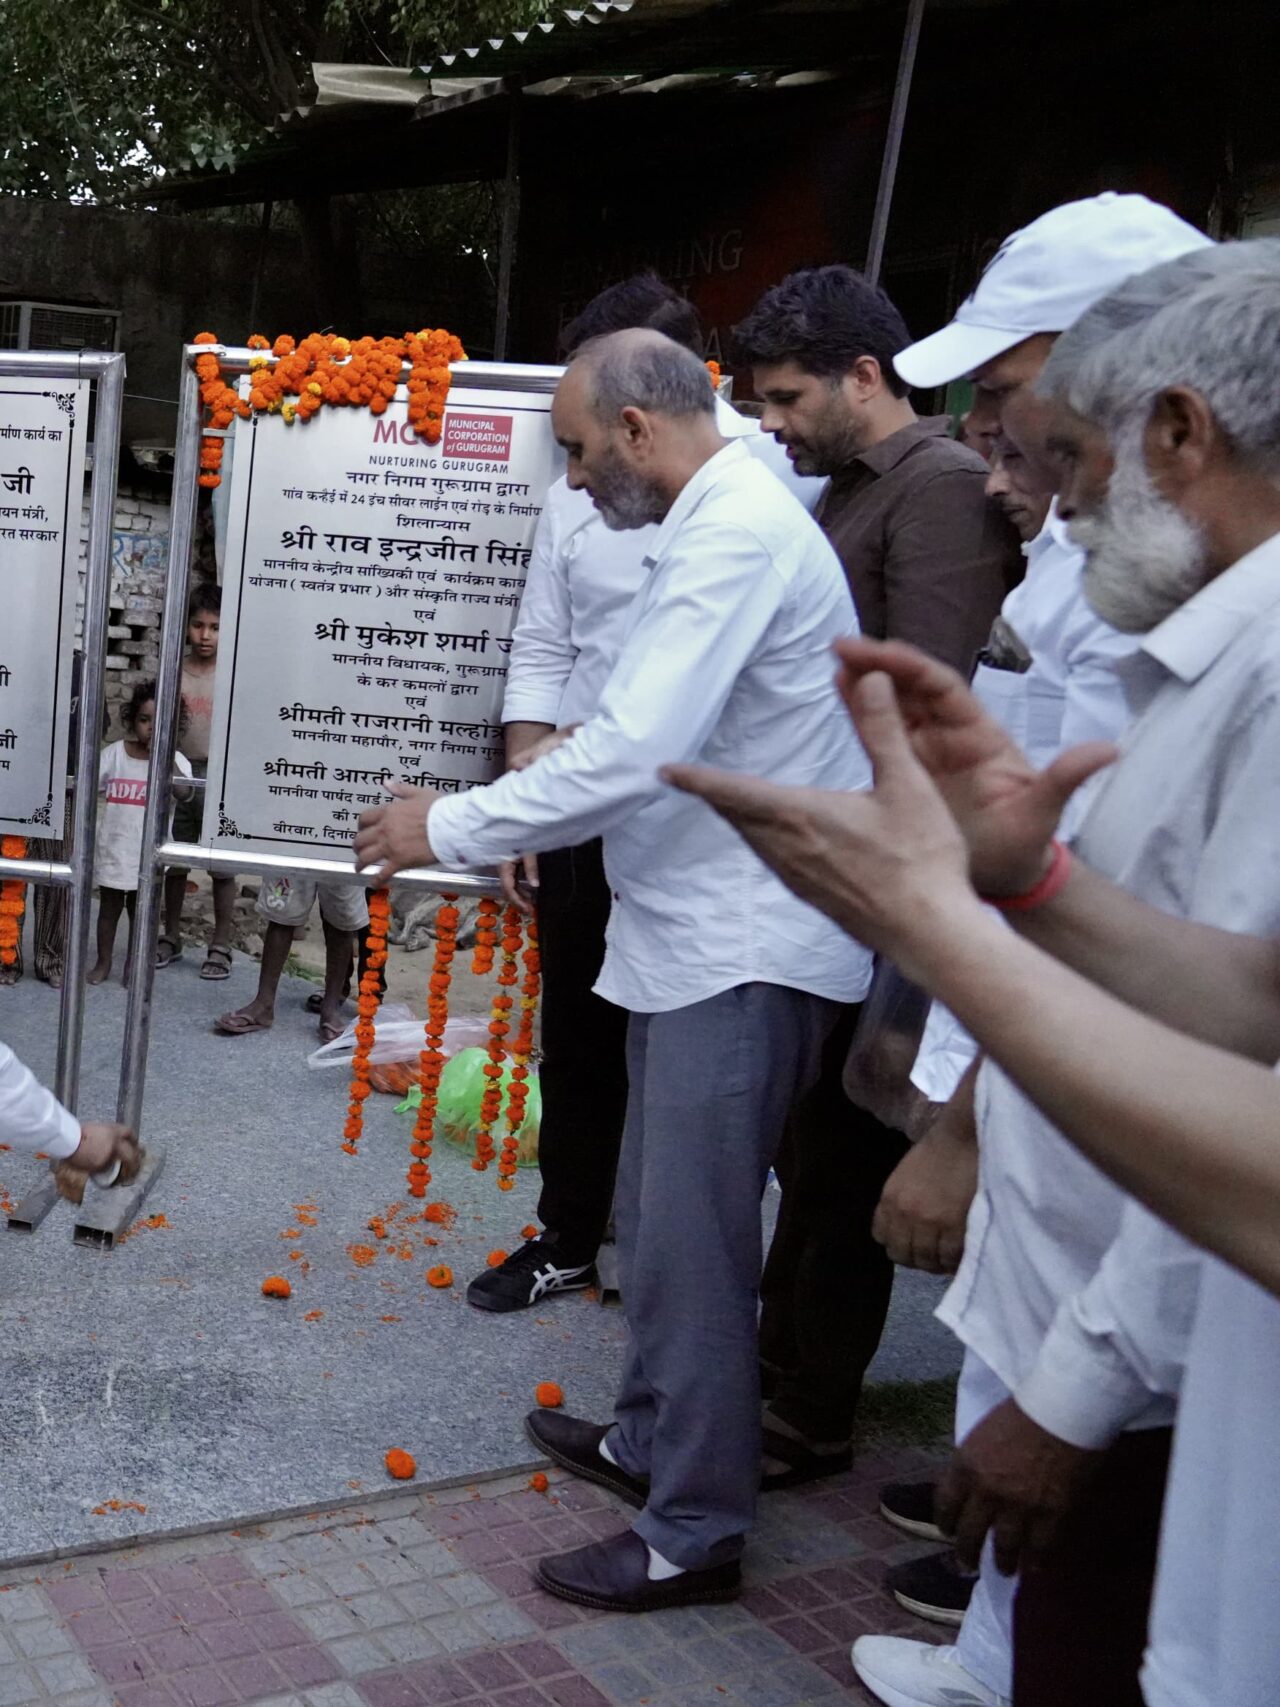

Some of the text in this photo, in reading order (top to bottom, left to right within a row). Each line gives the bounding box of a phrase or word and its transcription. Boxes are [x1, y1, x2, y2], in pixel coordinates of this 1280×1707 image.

[24, 428, 46, 441] कार्य
[48, 430, 62, 441] का
[449, 419, 495, 431] MUNICIPAL
[448, 430, 509, 442] CORPORATION
[447, 442, 506, 454] of GURUGRAM
[369, 455, 509, 474] NURTURING GURUGRAM
[1, 466, 35, 495] जी
[346, 470, 530, 497] नगर निगम गुरूग्राम द्वारा
[282, 486, 302, 499] गांव
[339, 490, 348, 503] में
[351, 494, 365, 505] 24
[369, 491, 386, 507] इंच
[389, 492, 416, 508] सीवर
[419, 496, 448, 511] लाईन
[451, 498, 468, 512] एवं
[471, 498, 491, 516] रोड़
[494, 500, 505, 514] के
[22, 505, 49, 522] मंत्री,
[396, 514, 471, 532] शिलान्यास
[19, 530, 59, 542] सरकार
[280, 525, 318, 551] श्री
[324, 533, 372, 554] राव
[378, 535, 479, 564] इन्द्रजीत
[263, 558, 309, 571] माननीय
[312, 559, 354, 576] केन्द्रीय
[356, 563, 414, 581] सांख्यिकी
[418, 568, 436, 582] एवं
[444, 570, 496, 586] कार्यक्रम
[249, 575, 287, 589] योजना
[299, 579, 335, 593] स्वतंत्र
[338, 583, 372, 596] प्रभार
[386, 584, 410, 599] और
[413, 586, 458, 604] संस्कृति
[461, 592, 491, 606] राज्य
[413, 608, 436, 621] एवं
[314, 618, 349, 641] श्री
[355, 621, 428, 648] मुकेश
[436, 631, 489, 653] शर्मा
[332, 652, 508, 678] माननीय विधायक, गुरूग्राम
[357, 674, 479, 696] के कर कमलों द्वारा
[405, 694, 427, 709] एवं
[278, 702, 347, 726] श्रीमती
[351, 712, 434, 735] राजरानी
[292, 729, 478, 756] माननीया महापौर, नगर निगम
[263, 758, 328, 781] श्रीमती
[399, 754, 421, 769] एवं
[268, 784, 318, 799] माननीया
[321, 786, 353, 806] पार्षद
[357, 789, 382, 805] वार्ड
[332, 809, 351, 822] की
[272, 822, 319, 839] वीरवार,
